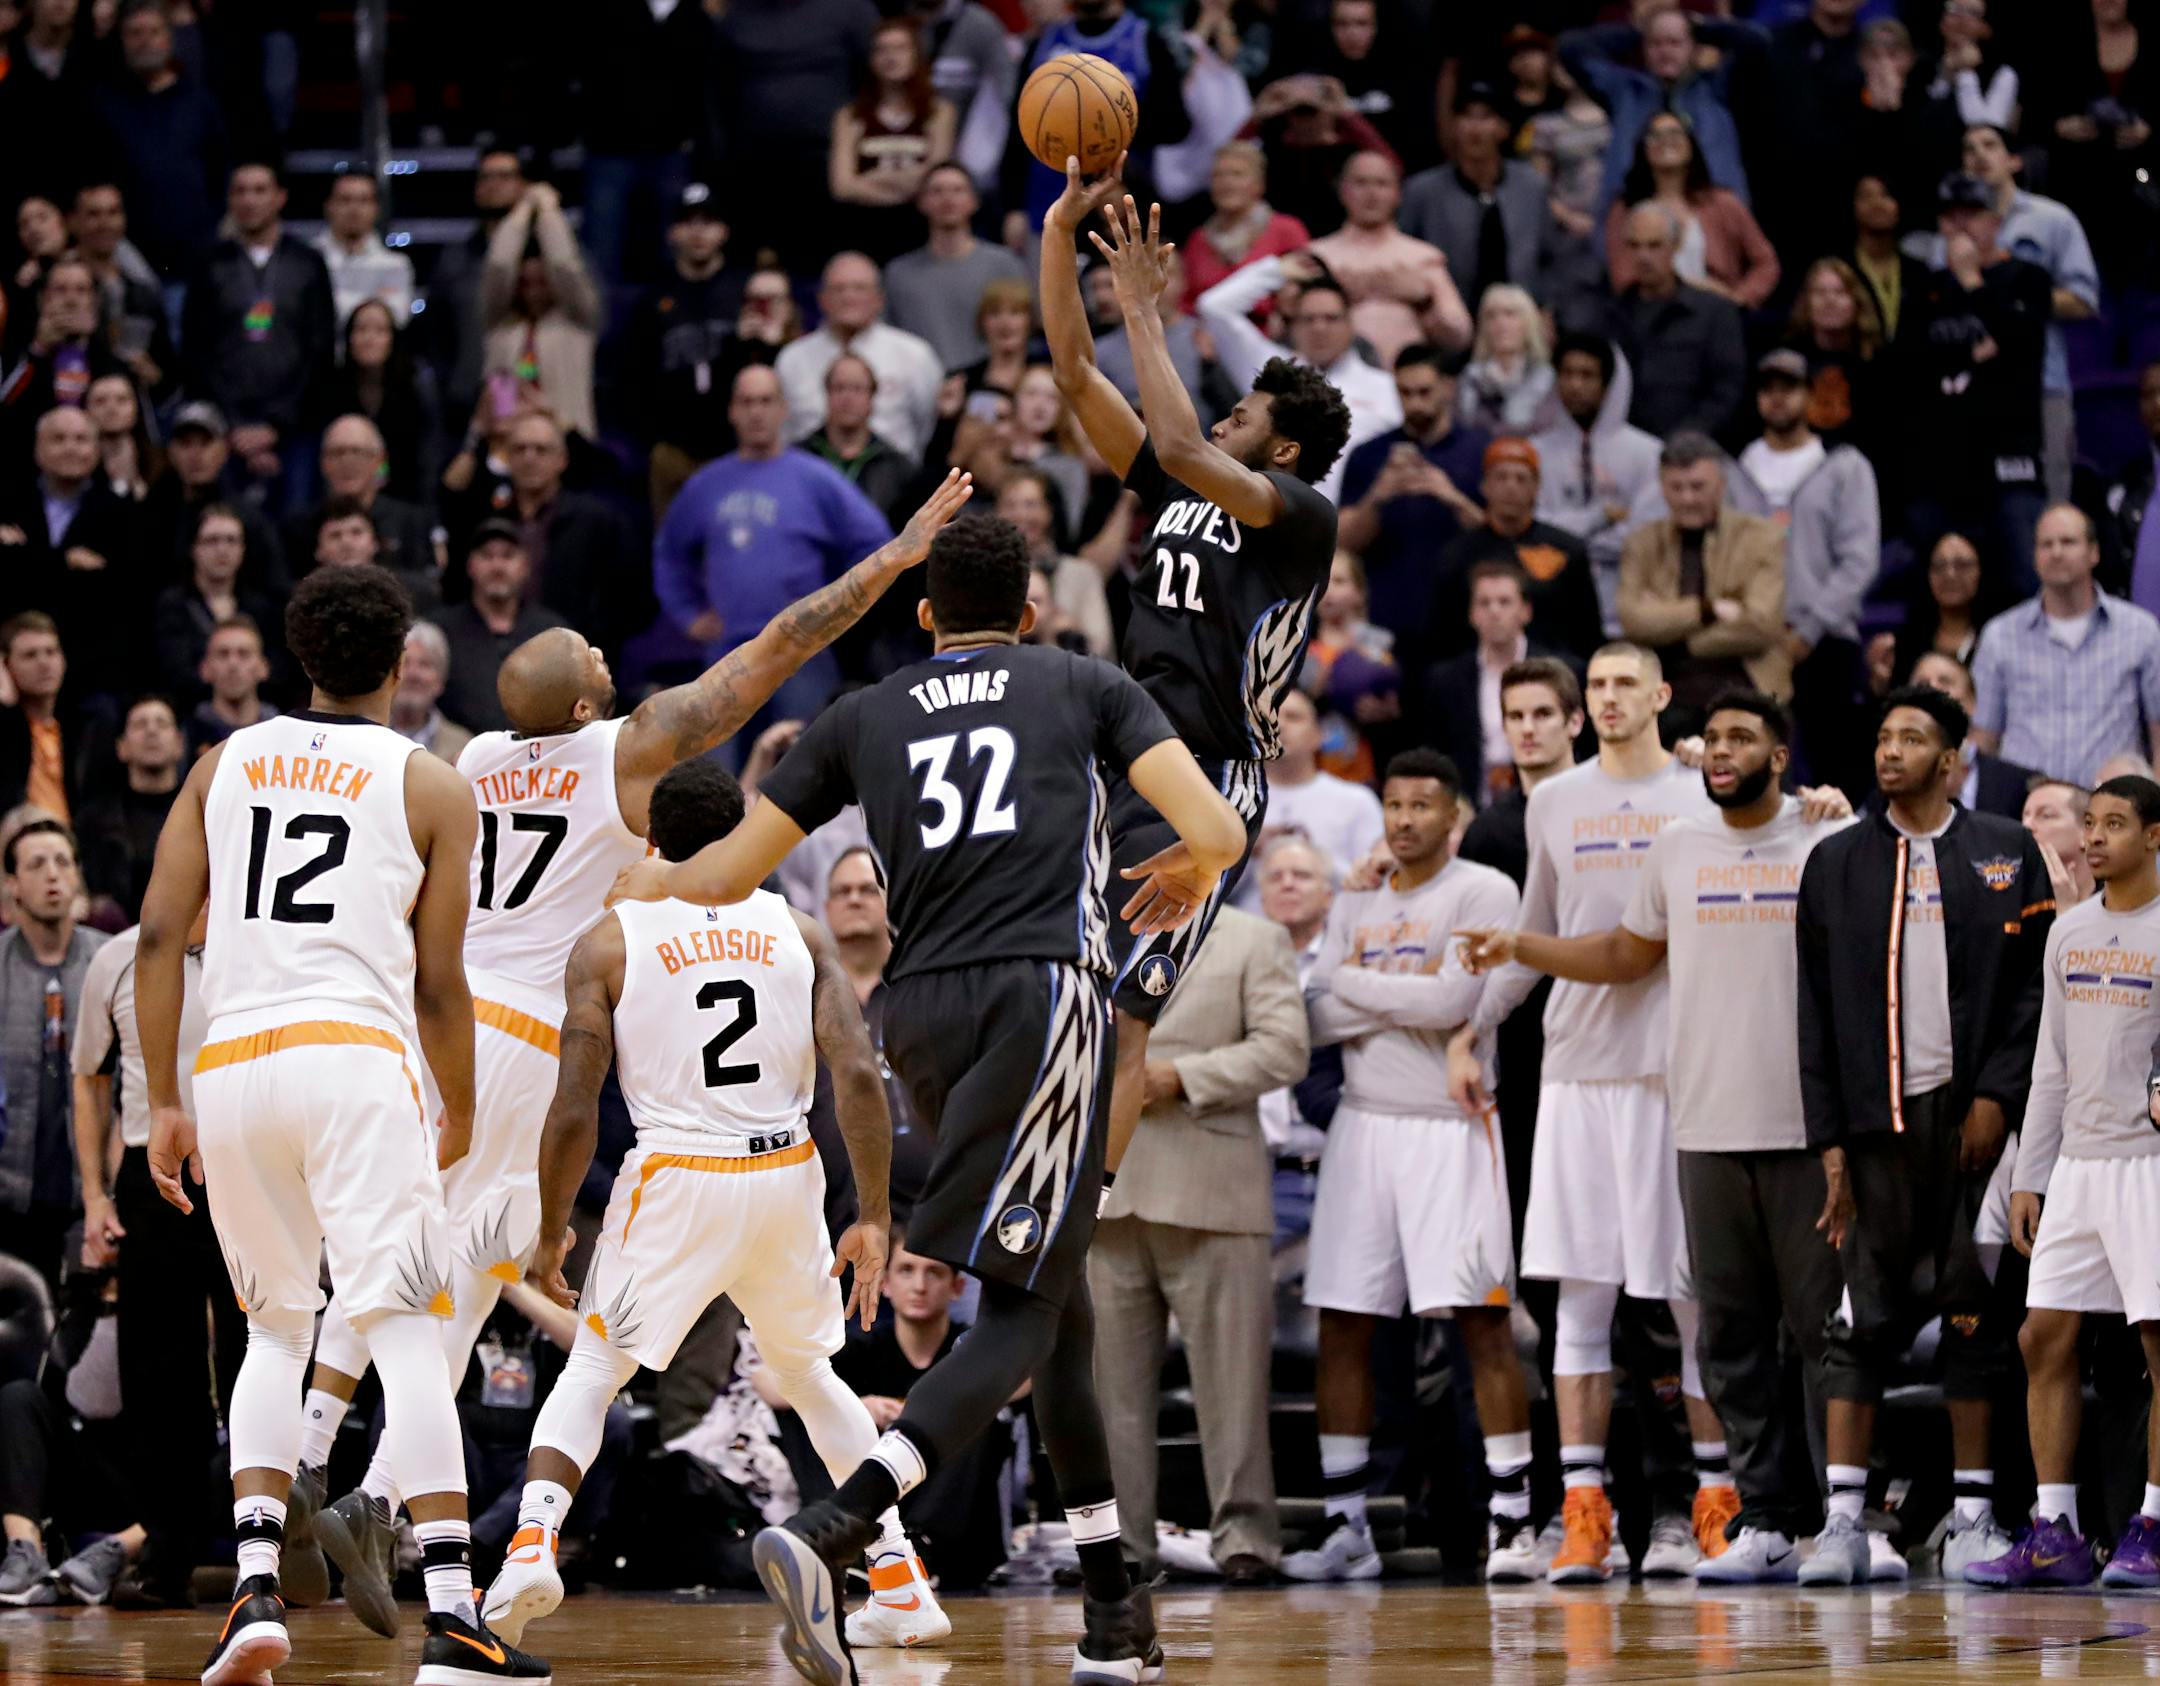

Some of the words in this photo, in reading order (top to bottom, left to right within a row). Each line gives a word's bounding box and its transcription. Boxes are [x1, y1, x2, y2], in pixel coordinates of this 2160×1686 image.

[1156, 547, 1205, 613] 22
[908, 669, 1010, 715] TOWNS
[242, 754, 374, 802] WARREN
[476, 767, 581, 806] TUCKER
[907, 725, 1018, 850] 32
[244, 805, 352, 924] 12
[476, 810, 569, 912] 17
[1696, 863, 1799, 889] PHOENIX
[655, 928, 778, 977] BLEDSOE
[2066, 949, 2158, 977] PHOENIX
[695, 978, 759, 1089] 2
